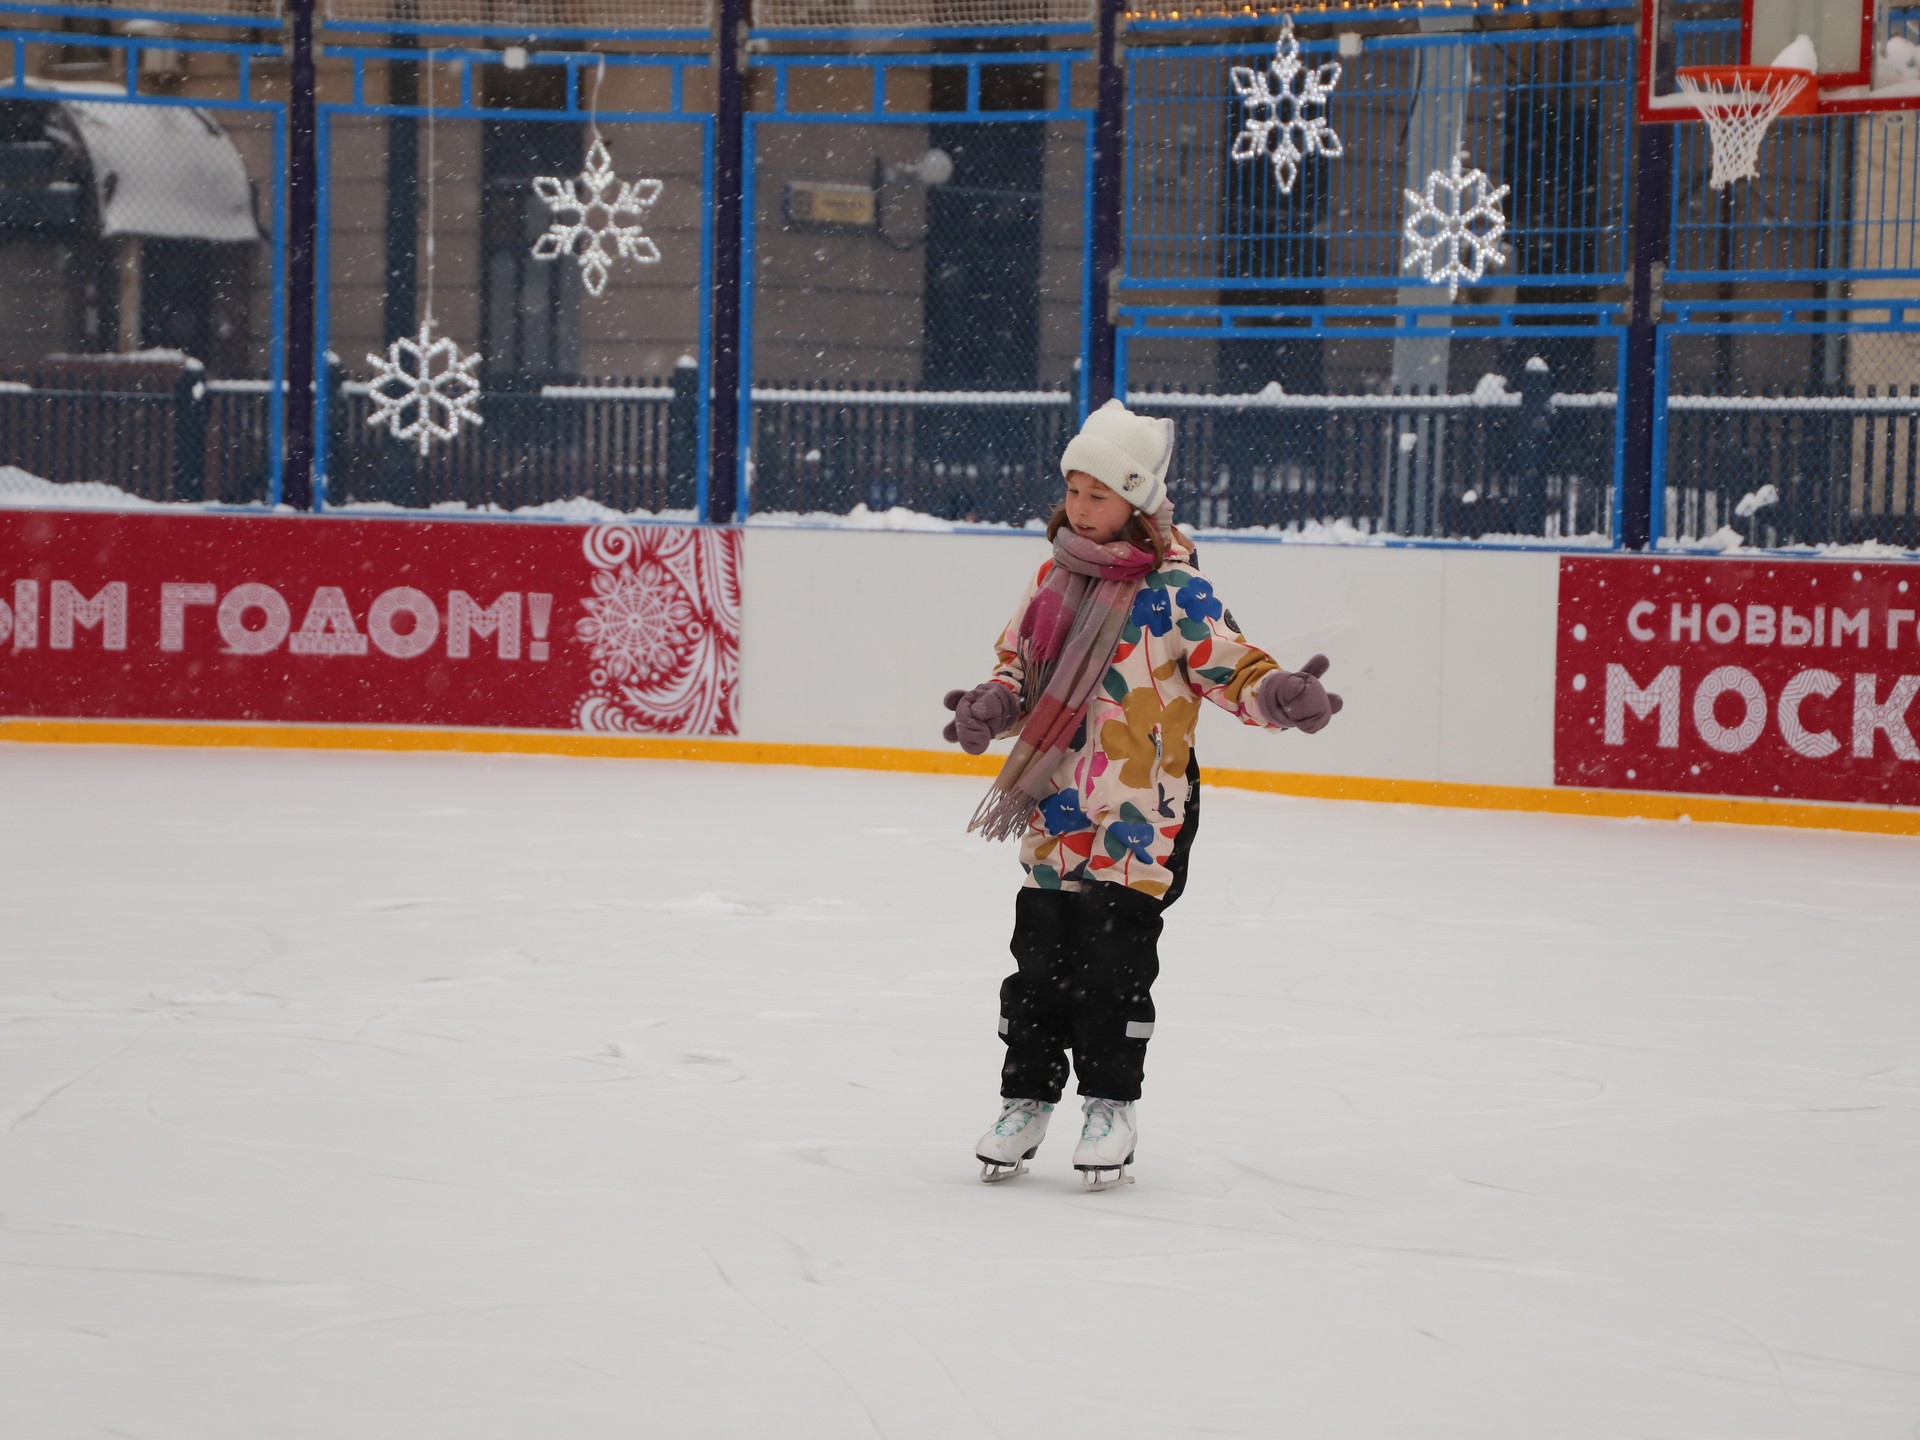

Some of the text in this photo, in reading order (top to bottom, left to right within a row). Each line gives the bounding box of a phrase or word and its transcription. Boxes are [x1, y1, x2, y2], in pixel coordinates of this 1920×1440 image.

[160, 582, 554, 662] ГОДОМ!
[1626, 600, 1920, 650] С НОВЫМ Г
[1603, 662, 1920, 762] МОСК
